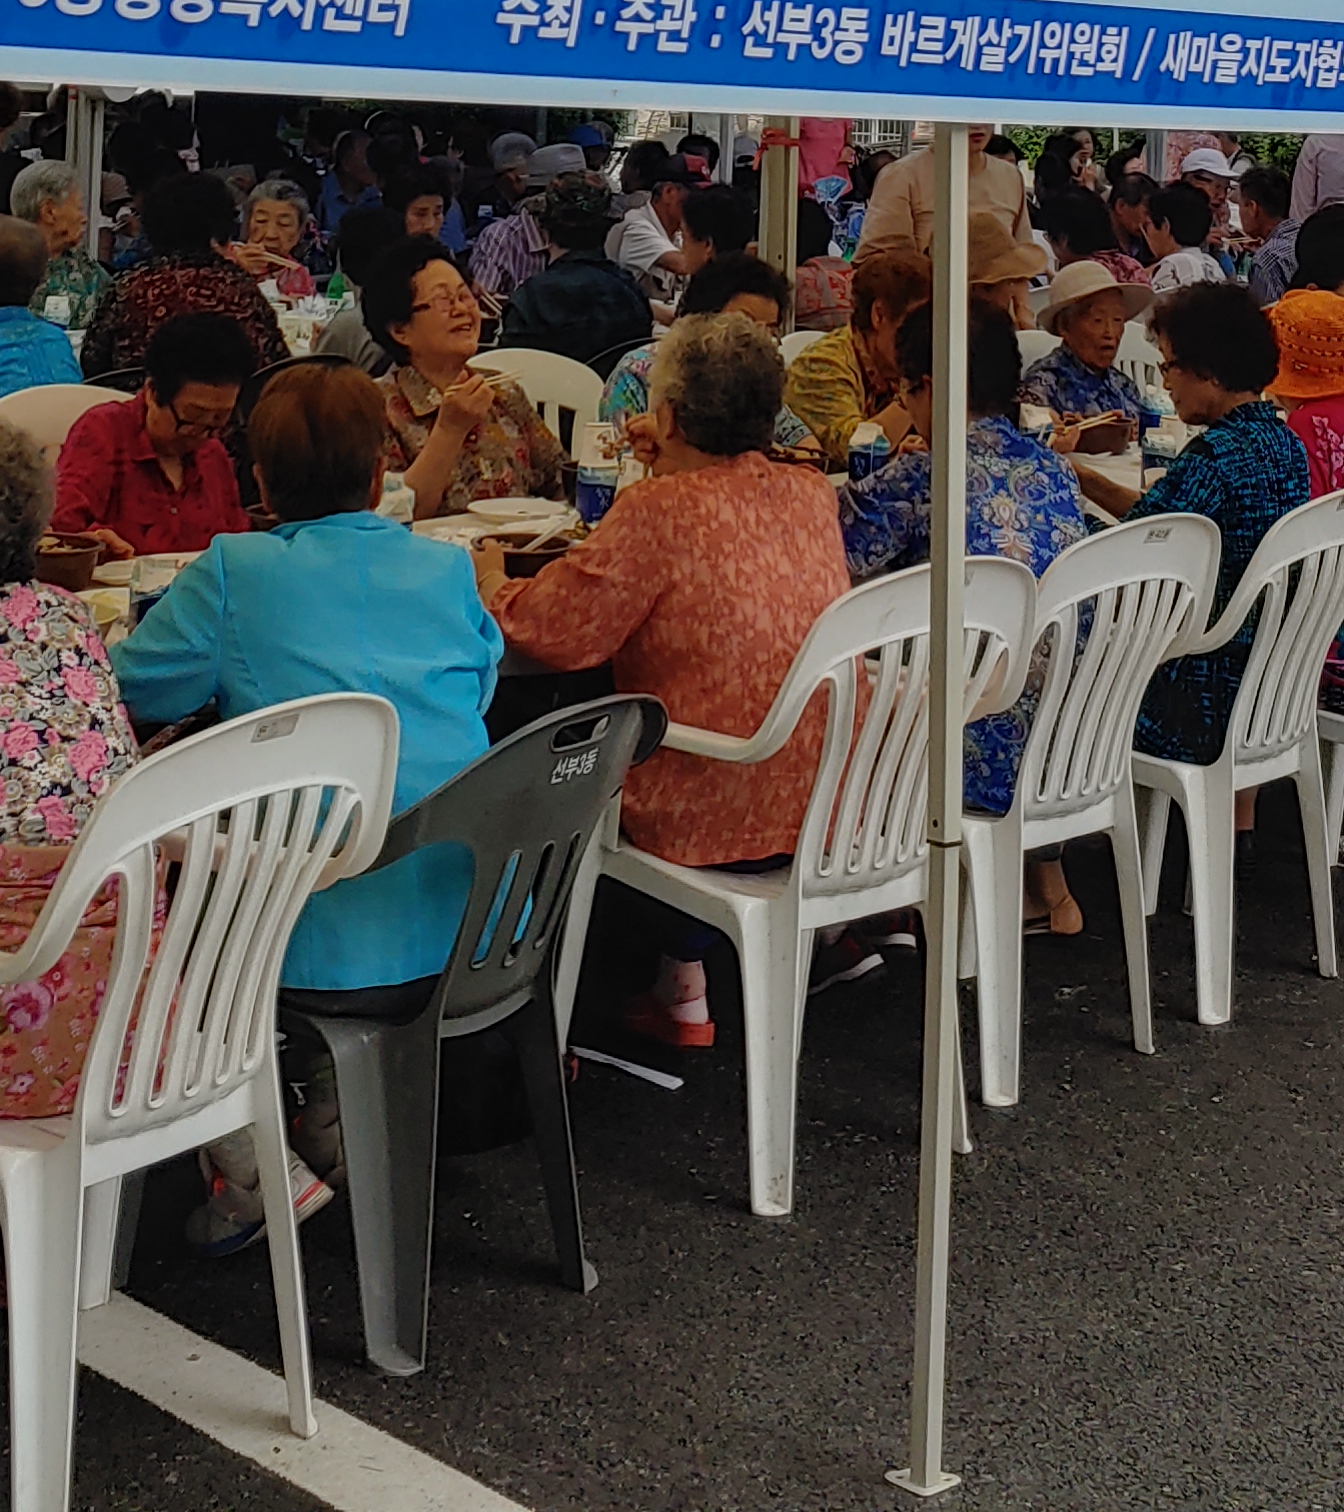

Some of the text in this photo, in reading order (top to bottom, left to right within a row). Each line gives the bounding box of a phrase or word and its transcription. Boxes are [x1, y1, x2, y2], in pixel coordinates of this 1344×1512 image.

[741, 0, 870, 65] 선부3동
[880, 9, 1131, 79] 바르게살기위원회
[549, 746, 600, 786] 선부3동
